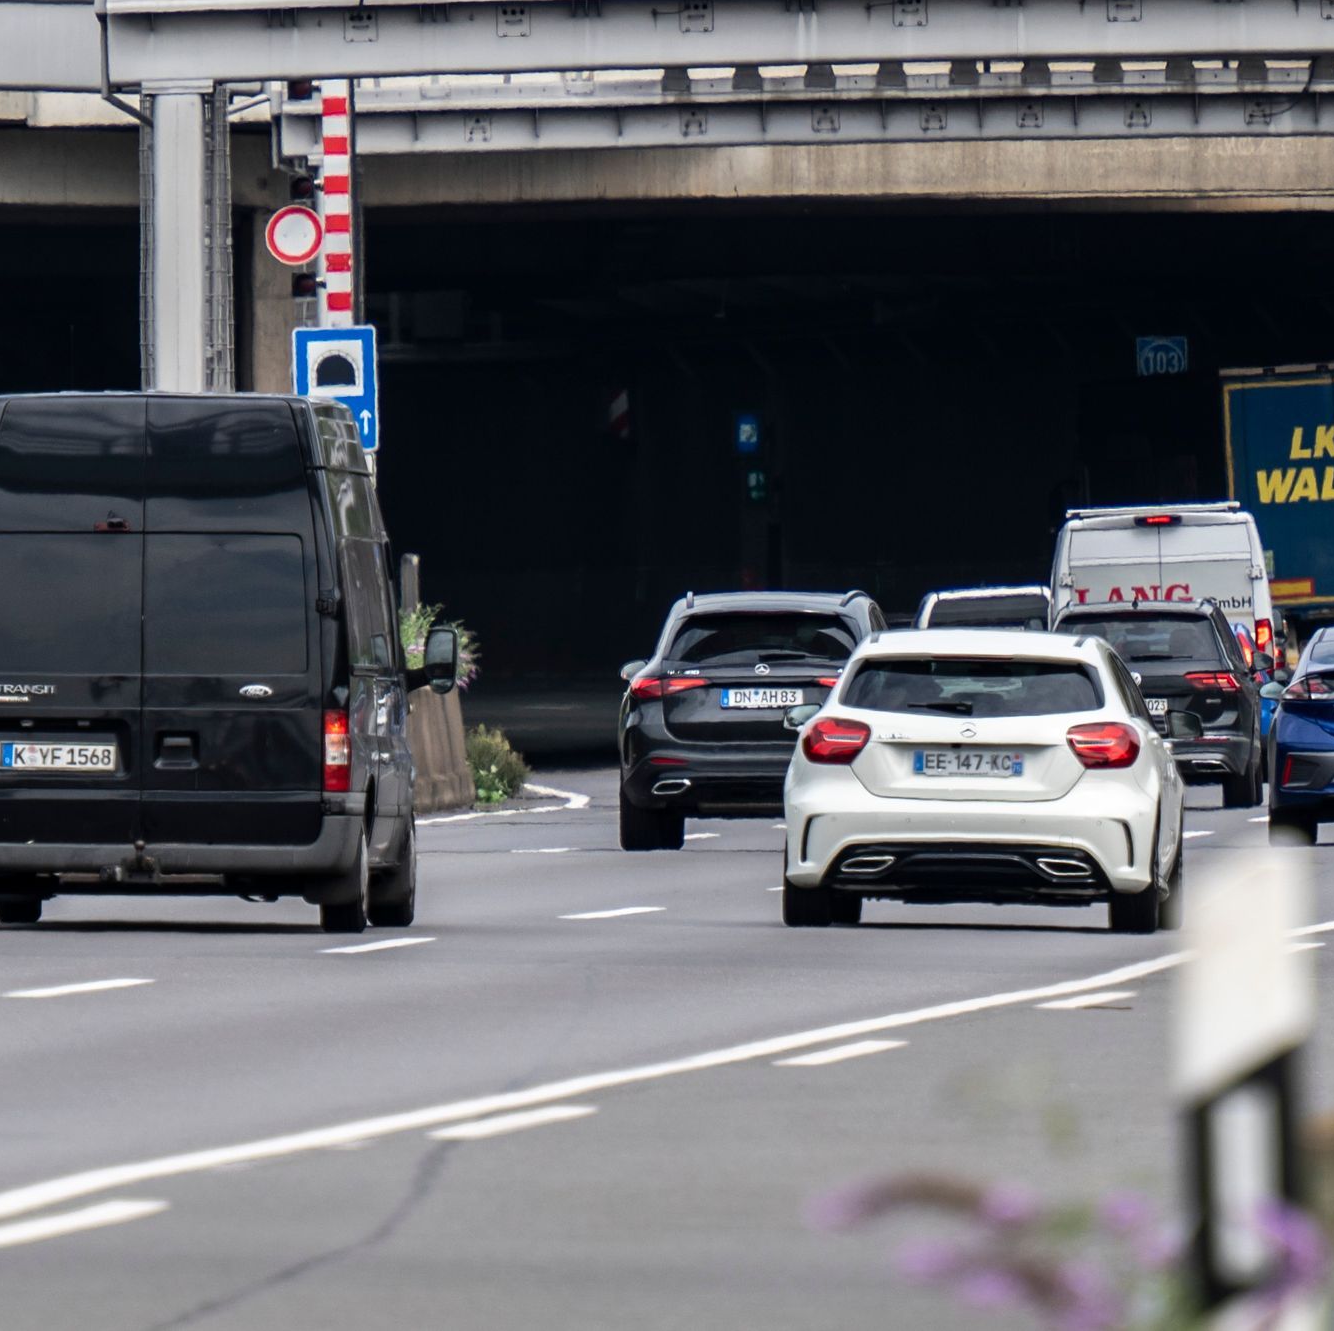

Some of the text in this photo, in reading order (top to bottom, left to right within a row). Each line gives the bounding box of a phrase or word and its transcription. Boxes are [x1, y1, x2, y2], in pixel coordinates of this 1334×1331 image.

[1147, 351, 1178, 374] 103
[734, 691, 797, 703] DN AH 83
[14, 747, 112, 766] K YF 1568
